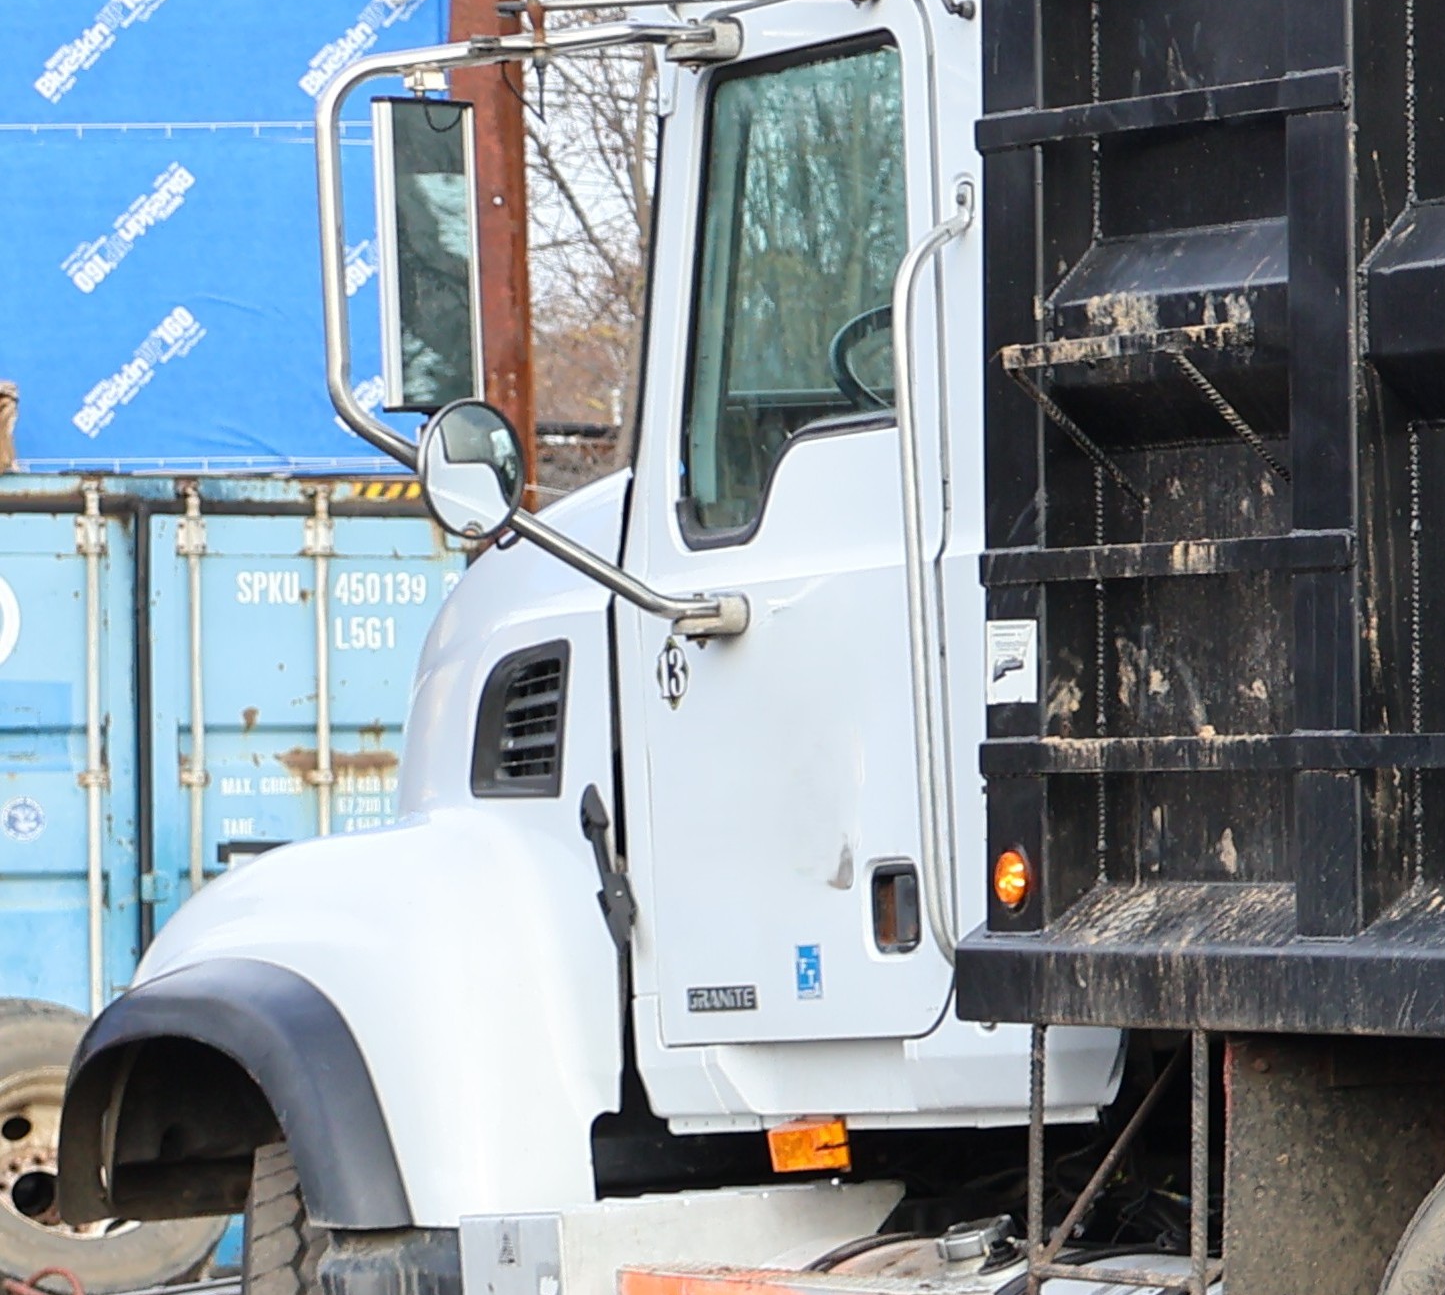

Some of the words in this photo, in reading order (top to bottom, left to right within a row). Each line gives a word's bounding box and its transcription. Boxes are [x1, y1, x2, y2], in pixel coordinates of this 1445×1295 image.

[237, 571, 300, 604] SPKU
[335, 572, 426, 605] 450139
[335, 617, 395, 649] L5G1
[659, 647, 687, 698] 13
